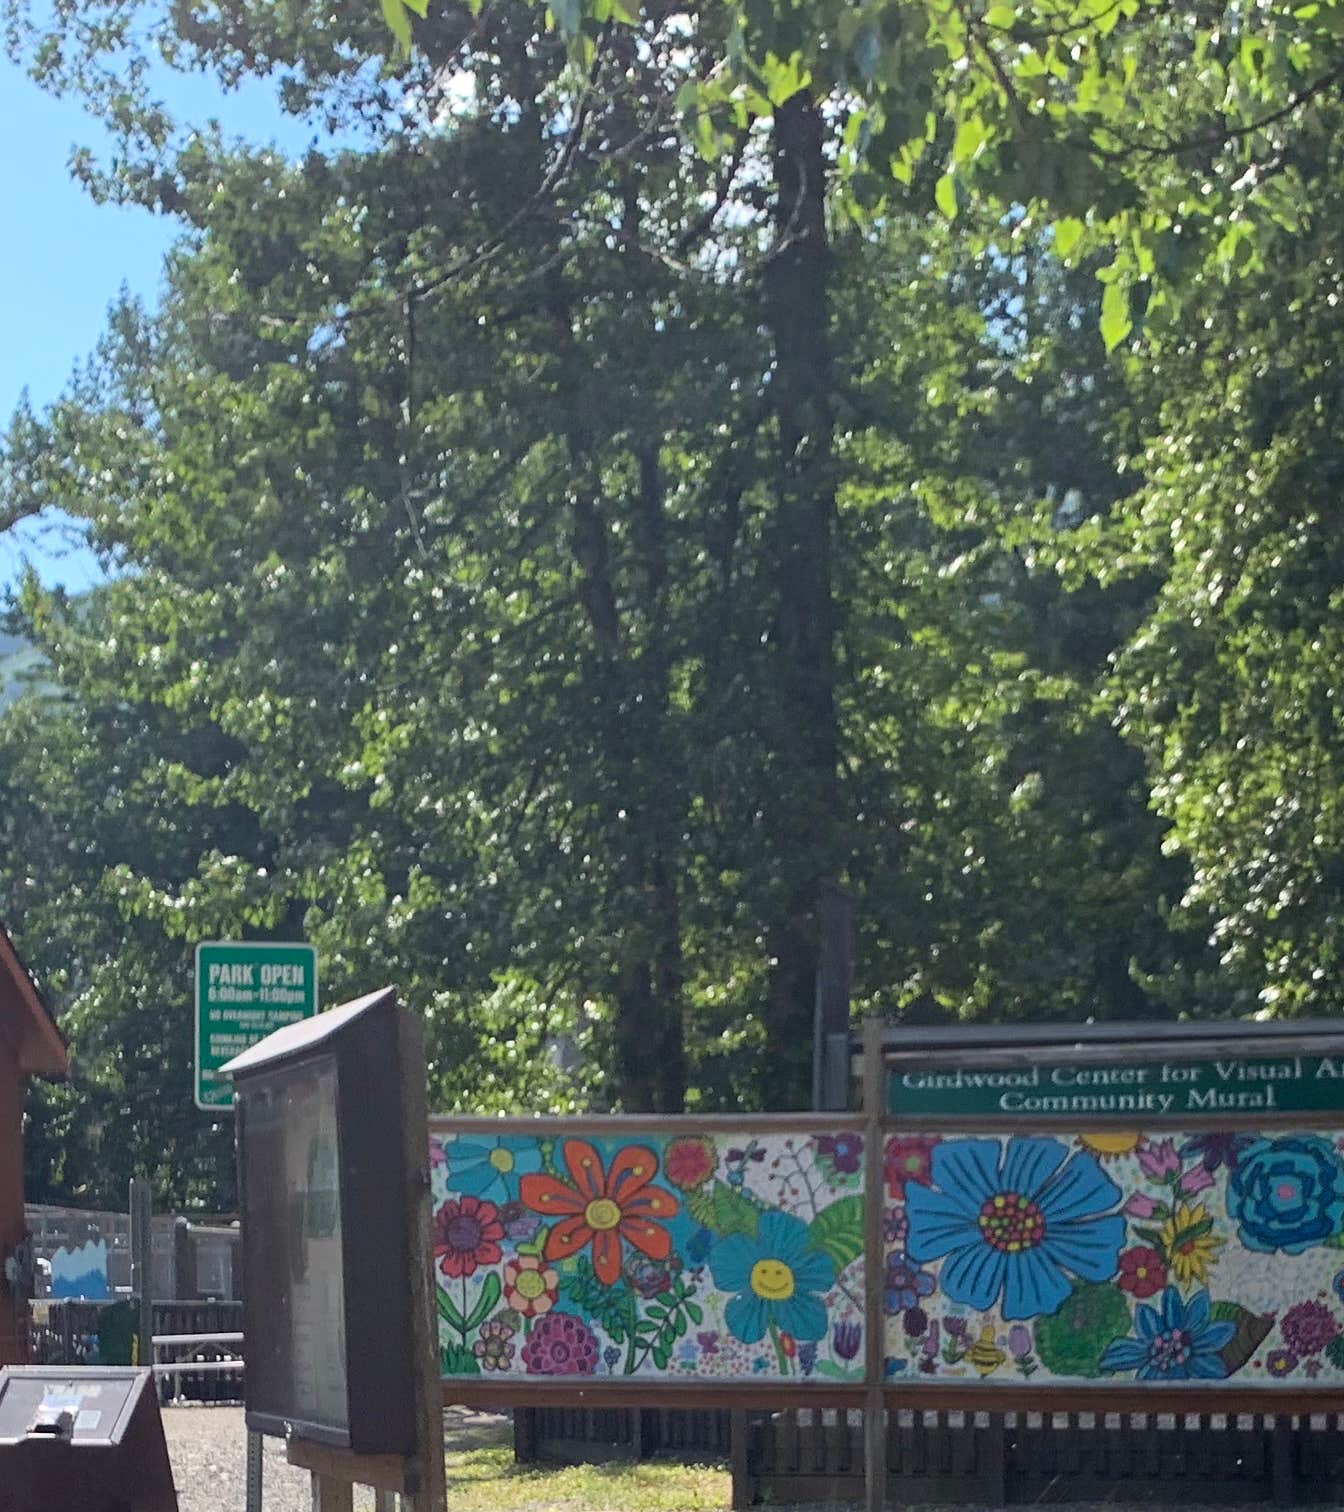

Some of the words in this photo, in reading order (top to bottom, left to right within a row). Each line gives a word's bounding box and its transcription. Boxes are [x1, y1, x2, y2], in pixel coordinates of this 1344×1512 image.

[209, 963, 254, 985] PARK
[260, 964, 304, 986] OPEN
[902, 1066, 1039, 1089] Girdwood
[1051, 1065, 1149, 1086] Center
[1161, 1062, 1203, 1083] for
[1213, 1057, 1302, 1081] Visual
[999, 1089, 1175, 1114] Community
[1185, 1084, 1277, 1109] Mural
